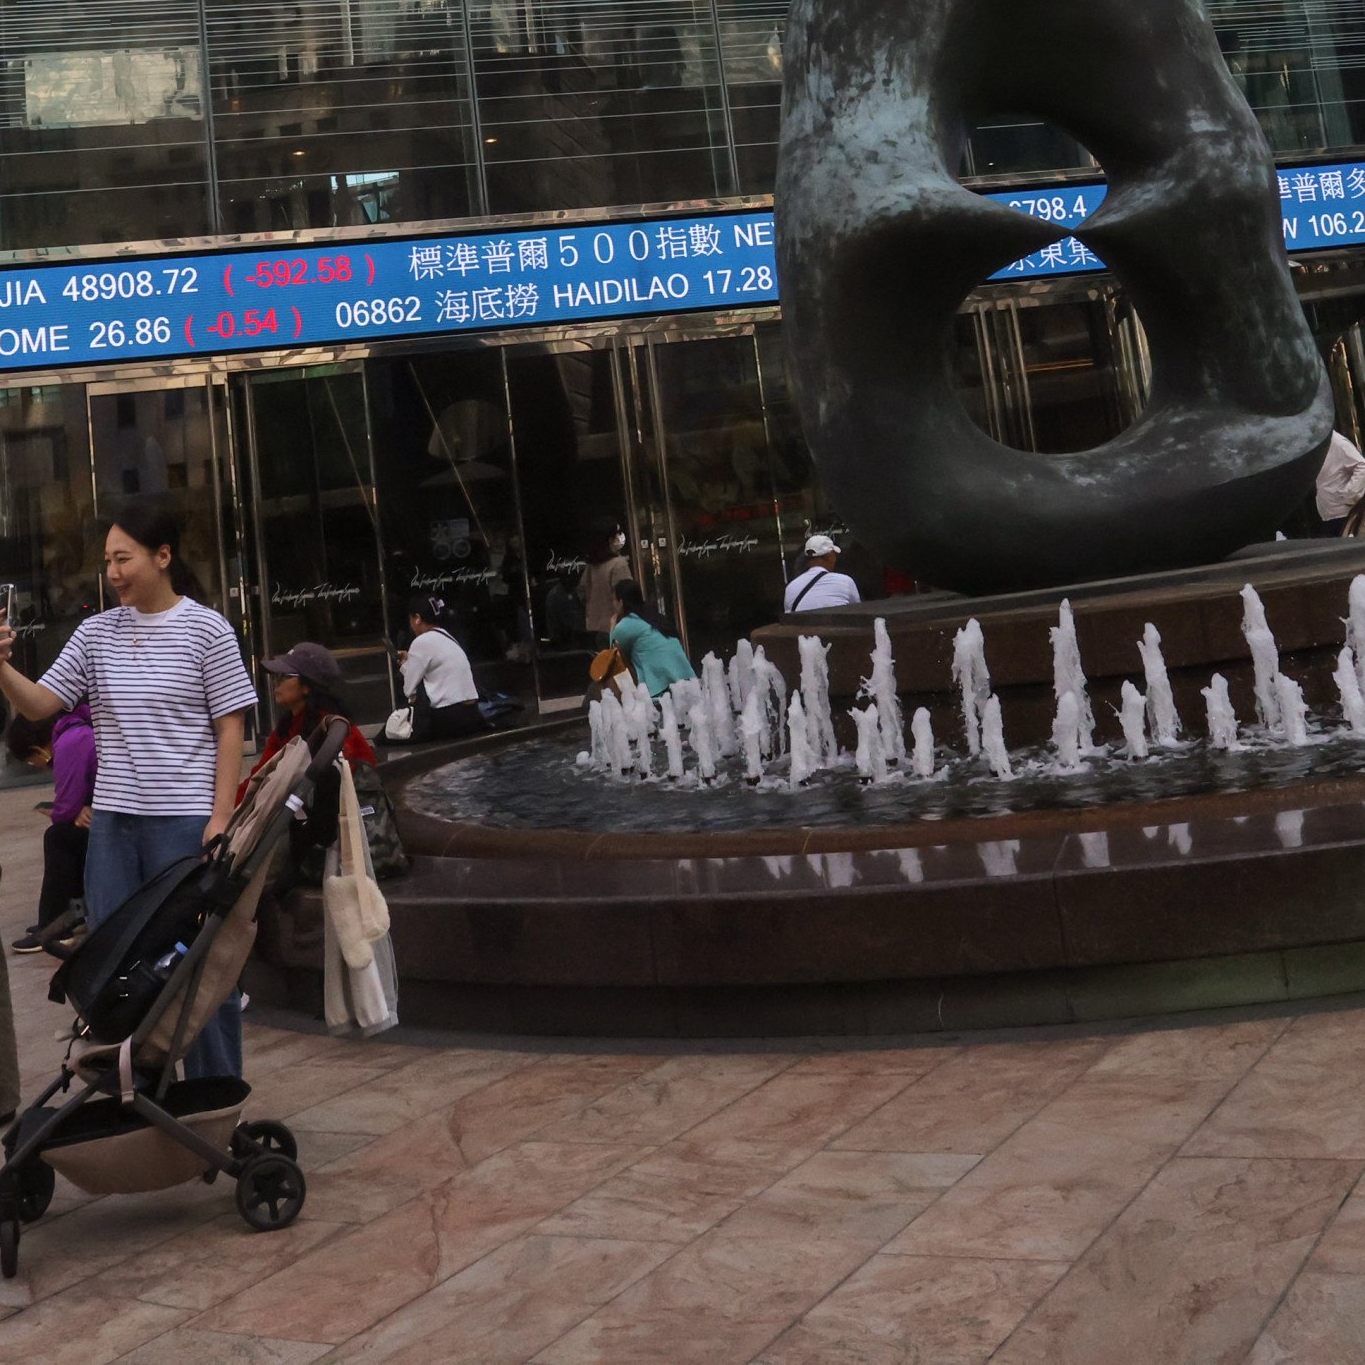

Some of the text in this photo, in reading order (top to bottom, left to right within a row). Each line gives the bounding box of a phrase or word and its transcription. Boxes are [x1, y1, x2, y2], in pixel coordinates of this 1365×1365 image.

[62, 267, 198, 301] 48908.72
[245, 255, 353, 288] -592.58
[734, 222, 774, 247] NE
[89, 316, 171, 348] 26.86
[207, 308, 279, 338] -0.54
[336, 296, 422, 328] 06862
[435, 282, 540, 323] 海底撈
[553, 273, 689, 308] HAIDILAO
[703, 266, 773, 294] 17.28
